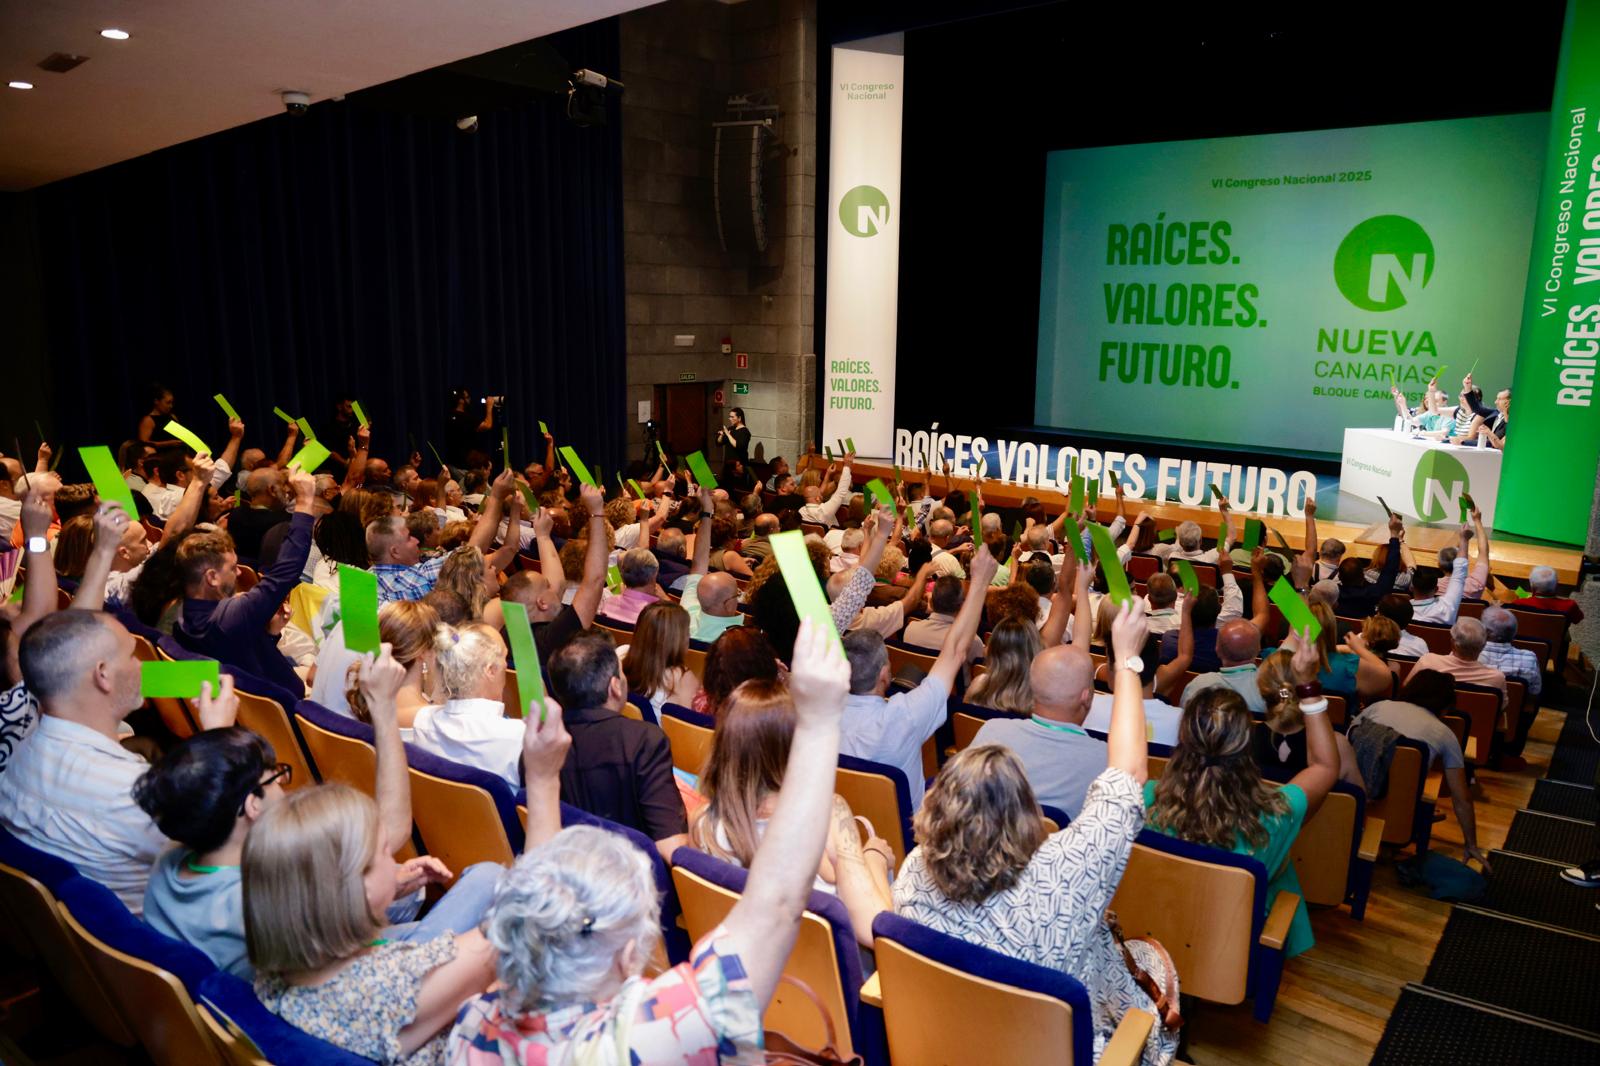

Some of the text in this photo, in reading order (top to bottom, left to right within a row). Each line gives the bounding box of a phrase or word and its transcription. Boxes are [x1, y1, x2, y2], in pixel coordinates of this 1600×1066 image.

[840, 82, 895, 92] VI Congreso
[847, 92, 887, 100] Nacional
[1211, 170, 1373, 189] VI Congreso Nacional 2025
[1541, 107, 1587, 317] VI Congreso Nacional
[1106, 212, 1240, 265] RAÍCES.
[1103, 283, 1267, 328] VALORES.
[1316, 327, 1438, 357] NUEVA
[1554, 297, 1600, 407] RAÍCES
[831, 357, 873, 374] RAÍCES.
[1099, 341, 1240, 389] FUTURO.
[1314, 360, 1437, 384] CANARIAS
[830, 378, 882, 393] VALORES.
[1312, 386, 1359, 398] BLOQUE
[830, 396, 875, 410] FUTURO.
[895, 422, 1317, 519] RAÍCES VALORES FUTURO
